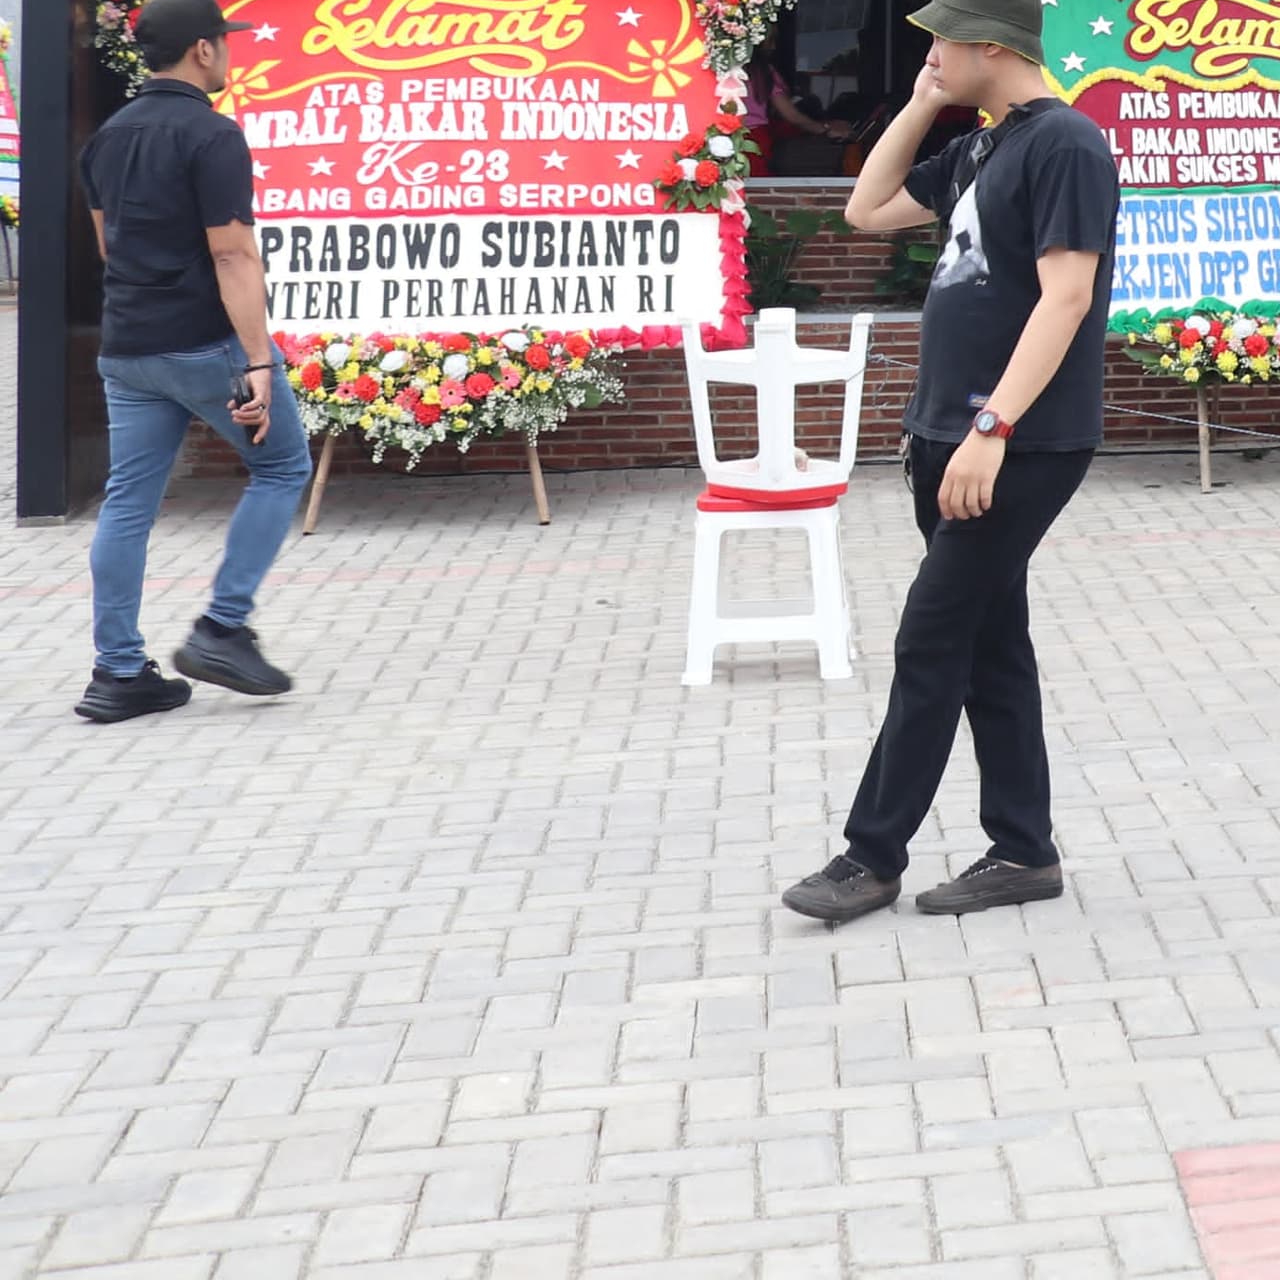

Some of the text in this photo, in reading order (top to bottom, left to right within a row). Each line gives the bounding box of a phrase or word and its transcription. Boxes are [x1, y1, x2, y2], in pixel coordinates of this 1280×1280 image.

[305, 75, 600, 109] ATAS PEMBUKAAN
[1119, 92, 1171, 120] ATAS
[230, 100, 690, 149] MBAL BAKAR INDONESIA
[1131, 127, 1203, 156] BAKAR
[356, 141, 510, 186] Ke-23
[1114, 156, 1171, 184] AKIN
[1176, 155, 1259, 183] SUKSES
[252, 182, 656, 213] ABANG GADING SERPONG
[1115, 198, 1199, 246] ETRUS
[260, 219, 681, 273] PRABOWO SUBIANTO
[1198, 249, 1250, 297] DPP
[265, 274, 675, 320] NTERI PERTAHANAN RI
